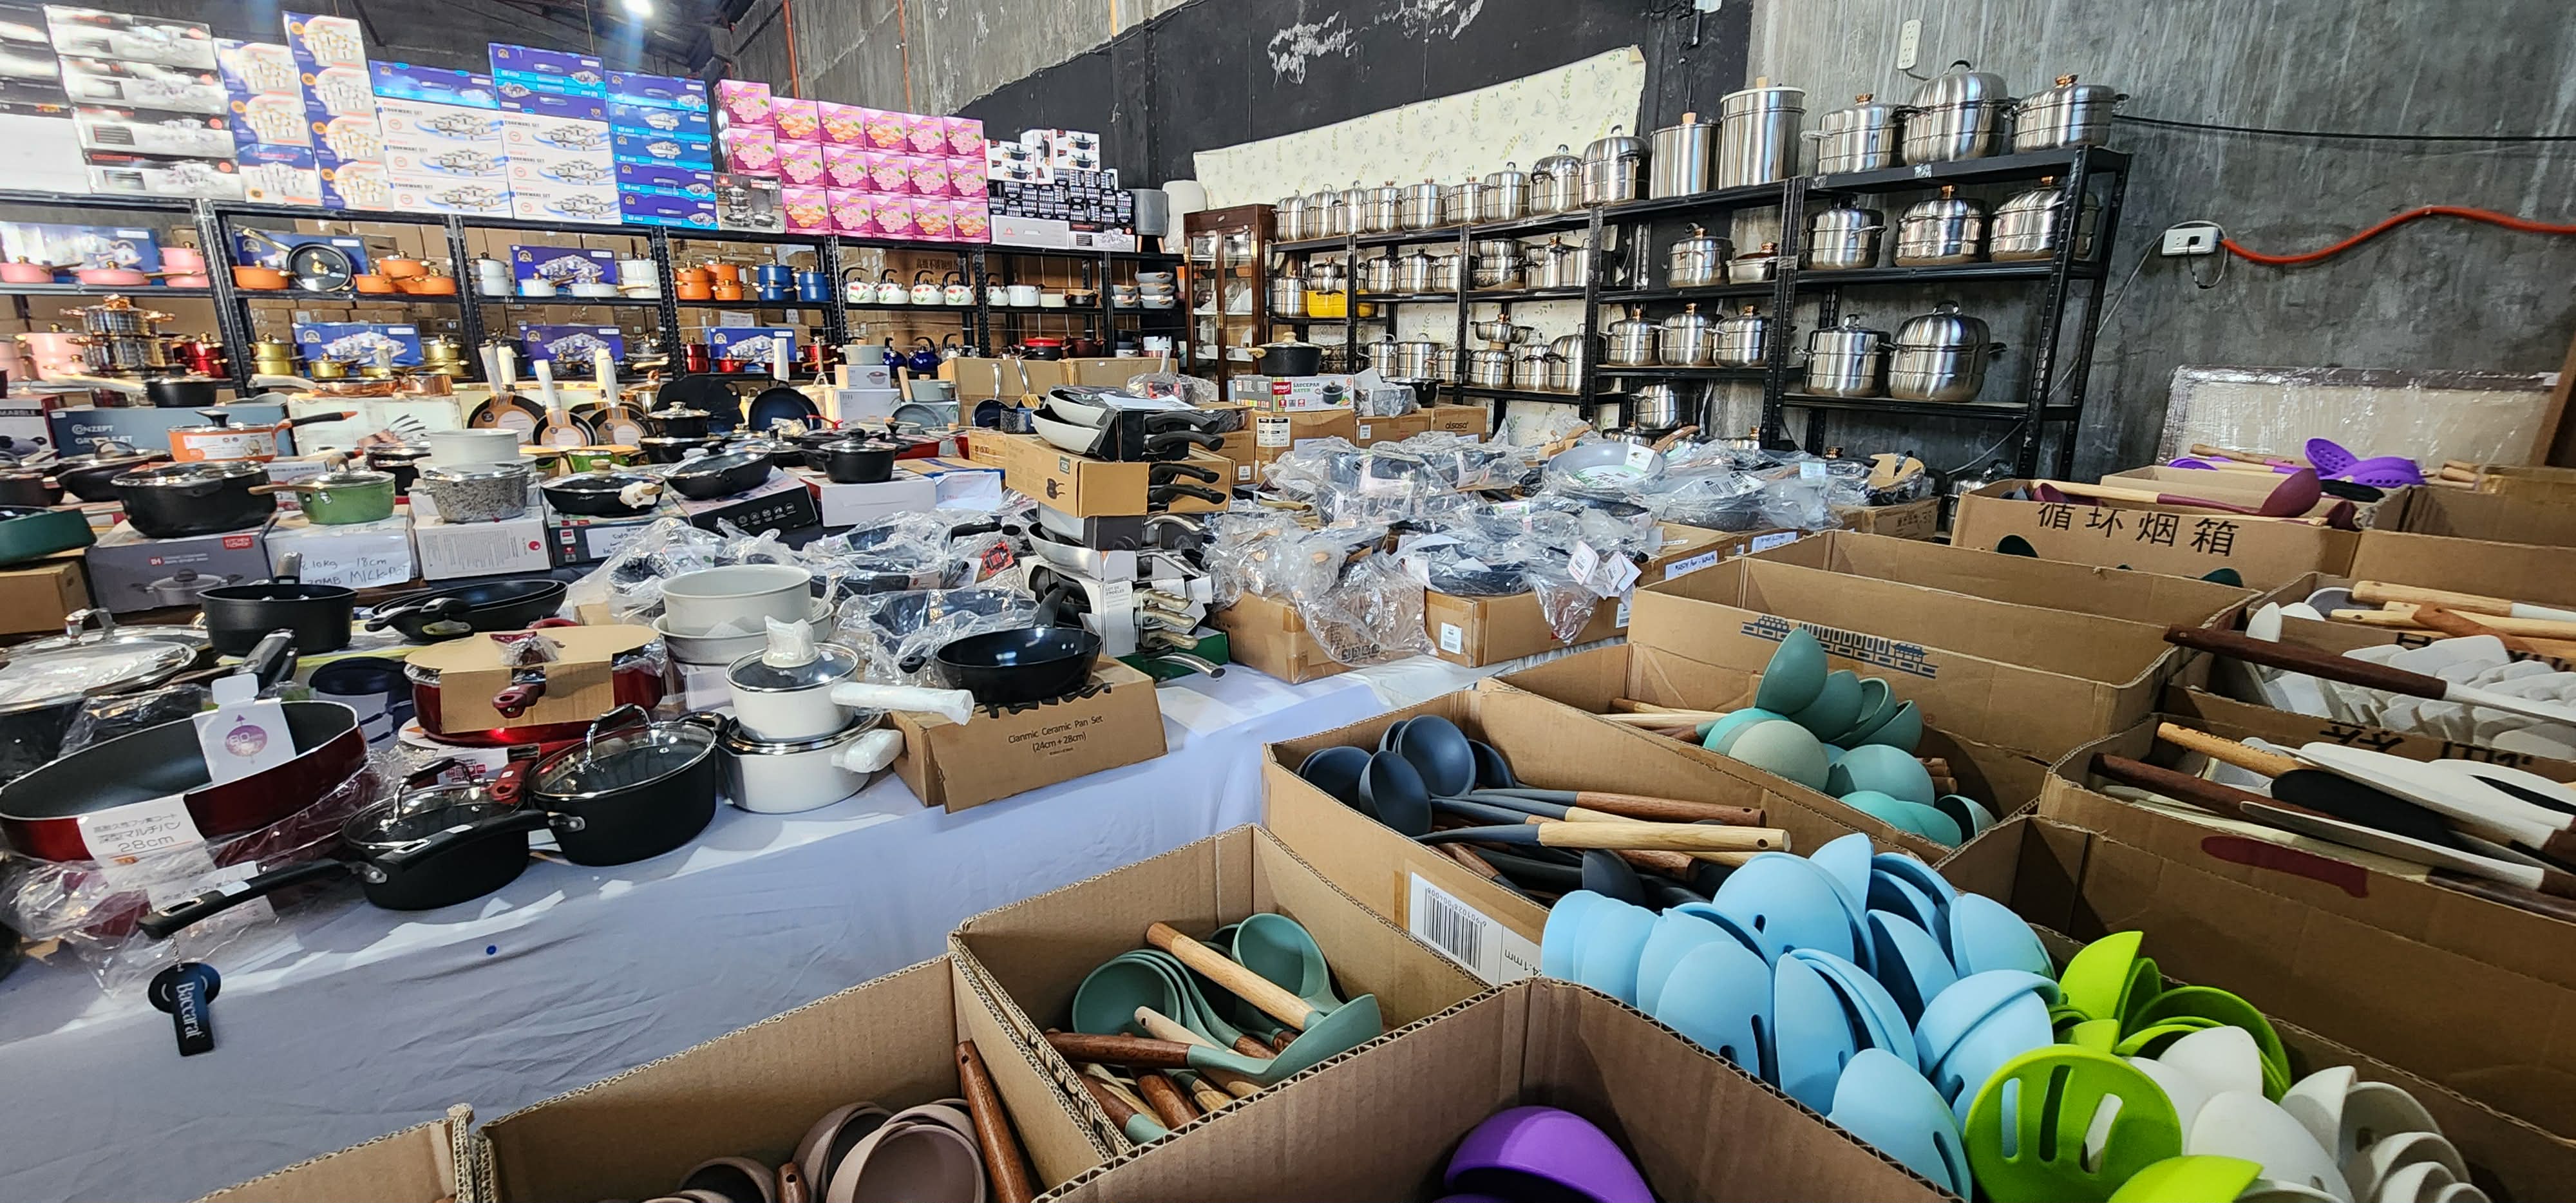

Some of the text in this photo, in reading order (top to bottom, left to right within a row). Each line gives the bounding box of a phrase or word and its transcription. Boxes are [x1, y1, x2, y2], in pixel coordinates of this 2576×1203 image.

[2038, 502, 2240, 556] 循环烟箱
[356, 557, 387, 566] 18cm
[1041, 723, 1072, 735] Ceramic
[1074, 719, 1088, 728] Pan
[1091, 715, 1104, 725] Set
[118, 836, 176, 853] 28cm
[176, 981, 204, 1039] Baccarat
